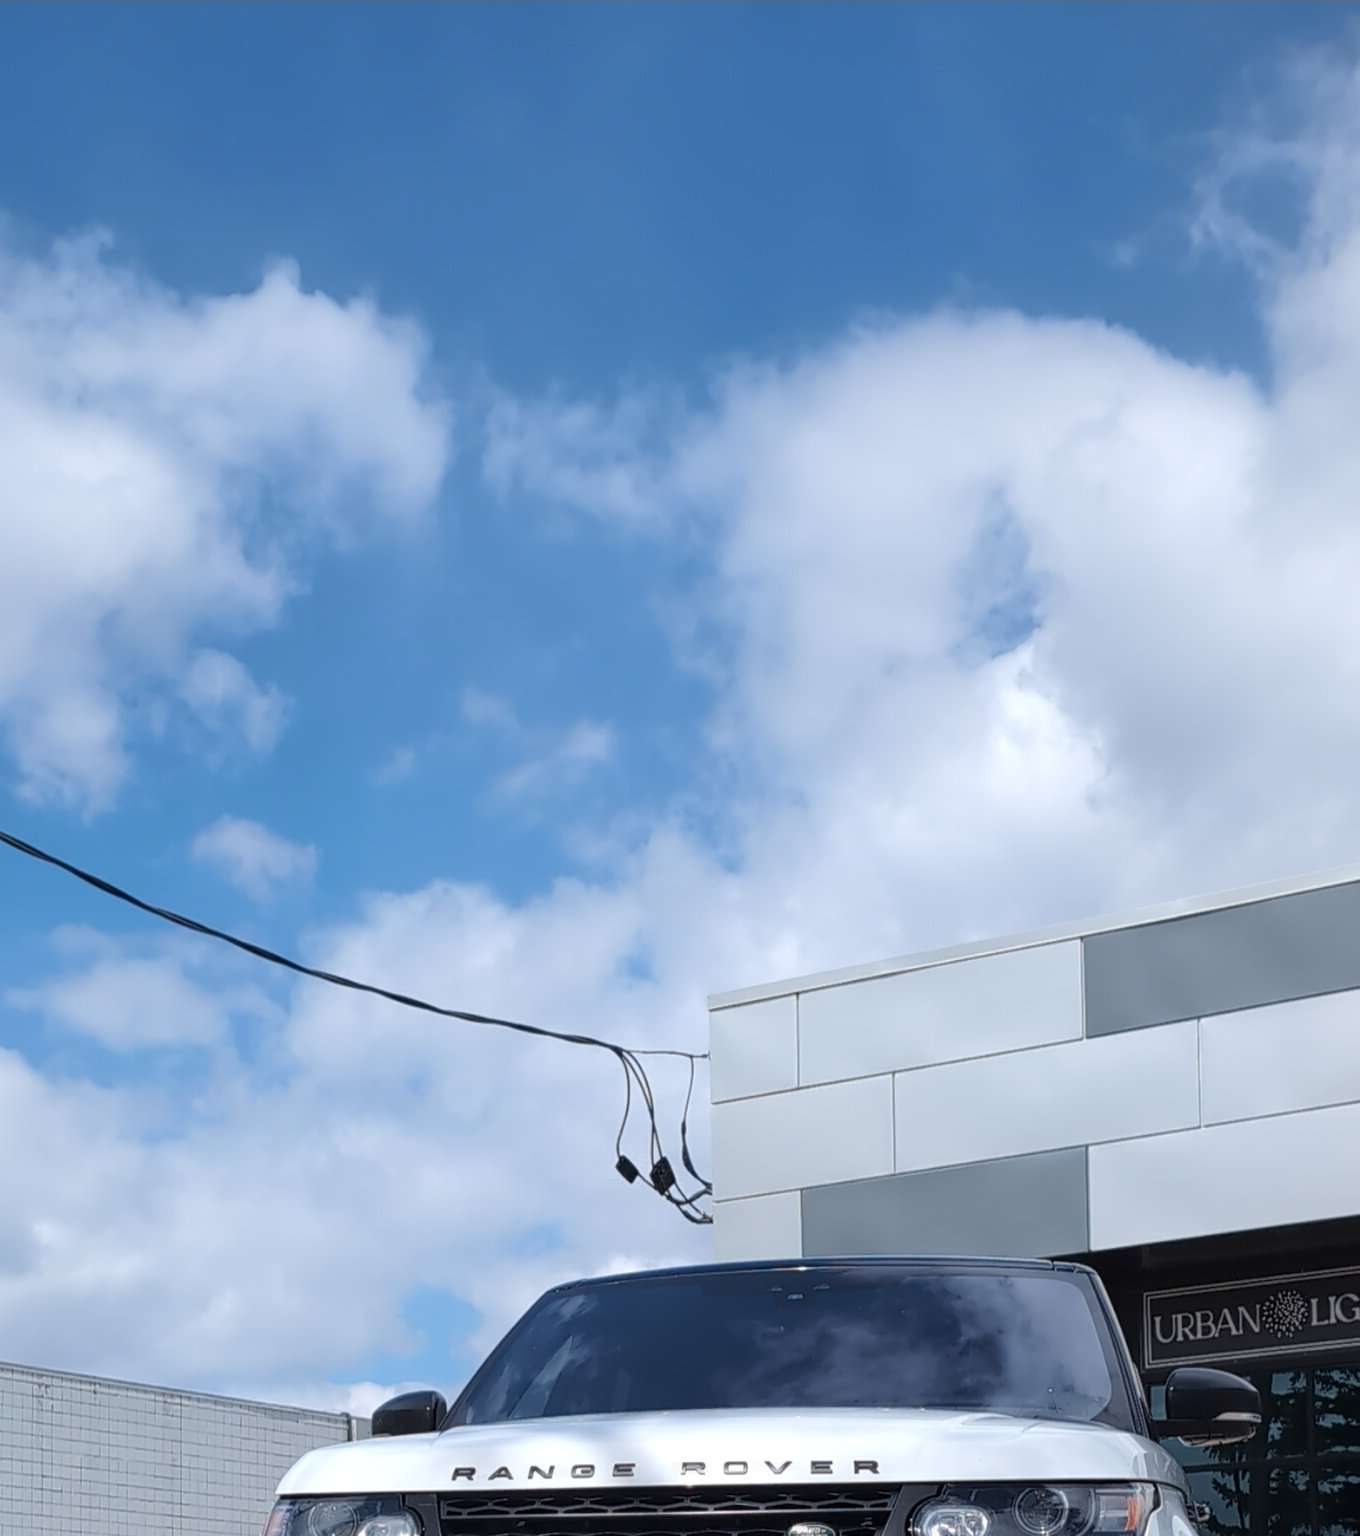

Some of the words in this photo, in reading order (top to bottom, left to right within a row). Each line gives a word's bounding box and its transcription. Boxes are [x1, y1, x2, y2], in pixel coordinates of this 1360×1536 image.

[1154, 1303, 1261, 1344] URBAN
[451, 1463, 636, 1481] RANGE
[681, 1460, 880, 1475] ROVER
